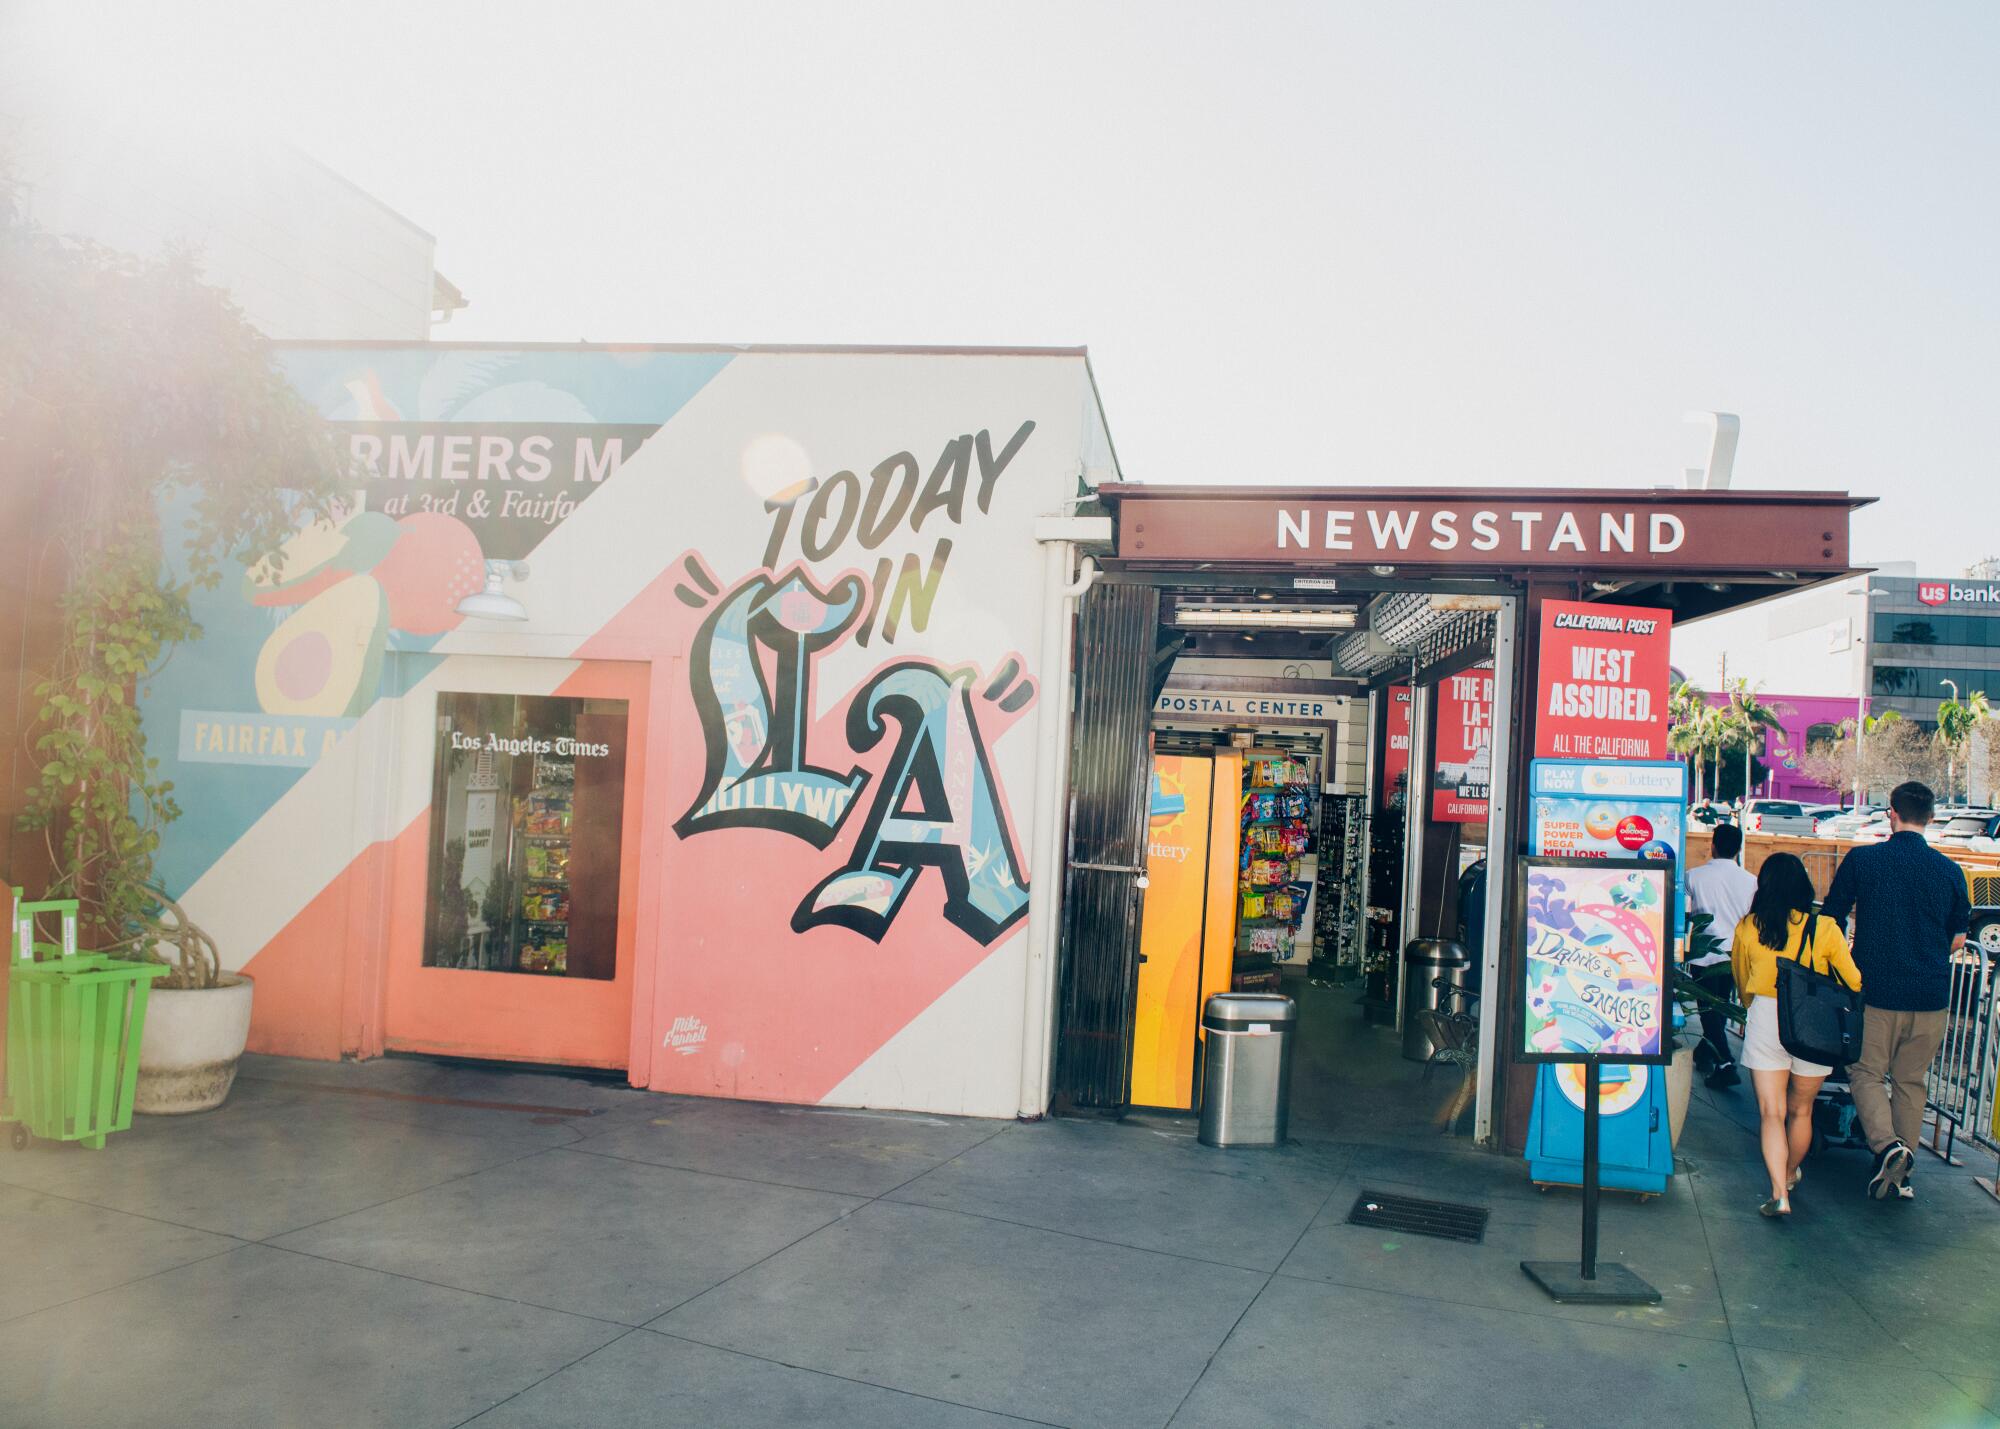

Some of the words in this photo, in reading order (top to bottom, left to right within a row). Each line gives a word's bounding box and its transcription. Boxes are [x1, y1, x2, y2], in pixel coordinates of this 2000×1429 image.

[384, 494, 409, 515] at
[420, 489, 460, 514] 3rd
[467, 489, 491, 518] &
[500, 490, 583, 524] Fairfa
[763, 420, 1036, 574] TODAY
[1276, 509, 1686, 554] NEWSSTAND
[855, 537, 953, 648] IN
[1949, 583, 2000, 602] bank
[1554, 613, 1623, 633] CALIFORNIA
[1625, 618, 1658, 635] POST
[1572, 646, 1635, 683] WEST
[1451, 675, 1480, 702] THE
[1161, 697, 1236, 713] POSTAL
[1246, 701, 1323, 717] CENTER
[1548, 682, 1658, 723] ASSURED.
[194, 722, 307, 757] FAIRFAX
[321, 728, 350, 753] A
[451, 731, 482, 750] Los
[484, 732, 551, 757] Angeles
[555, 736, 609, 757] Times
[1553, 734, 1571, 753] ALL
[1574, 735, 1592, 755] THE
[1594, 736, 1650, 758] CALIFORNIA
[1544, 768, 1576, 779] PLAY
[1544, 779, 1575, 789] NOW
[1458, 785, 1480, 798] WE'LL
[1447, 803, 1489, 815] CALIFORNIAP
[1543, 830, 1584, 839] POWER
[1544, 821, 1580, 830] SUPER
[1543, 839, 1575, 849] MEGA
[1543, 848, 1608, 858] MILLIONS
[1581, 983, 1651, 1029] SNACKS
